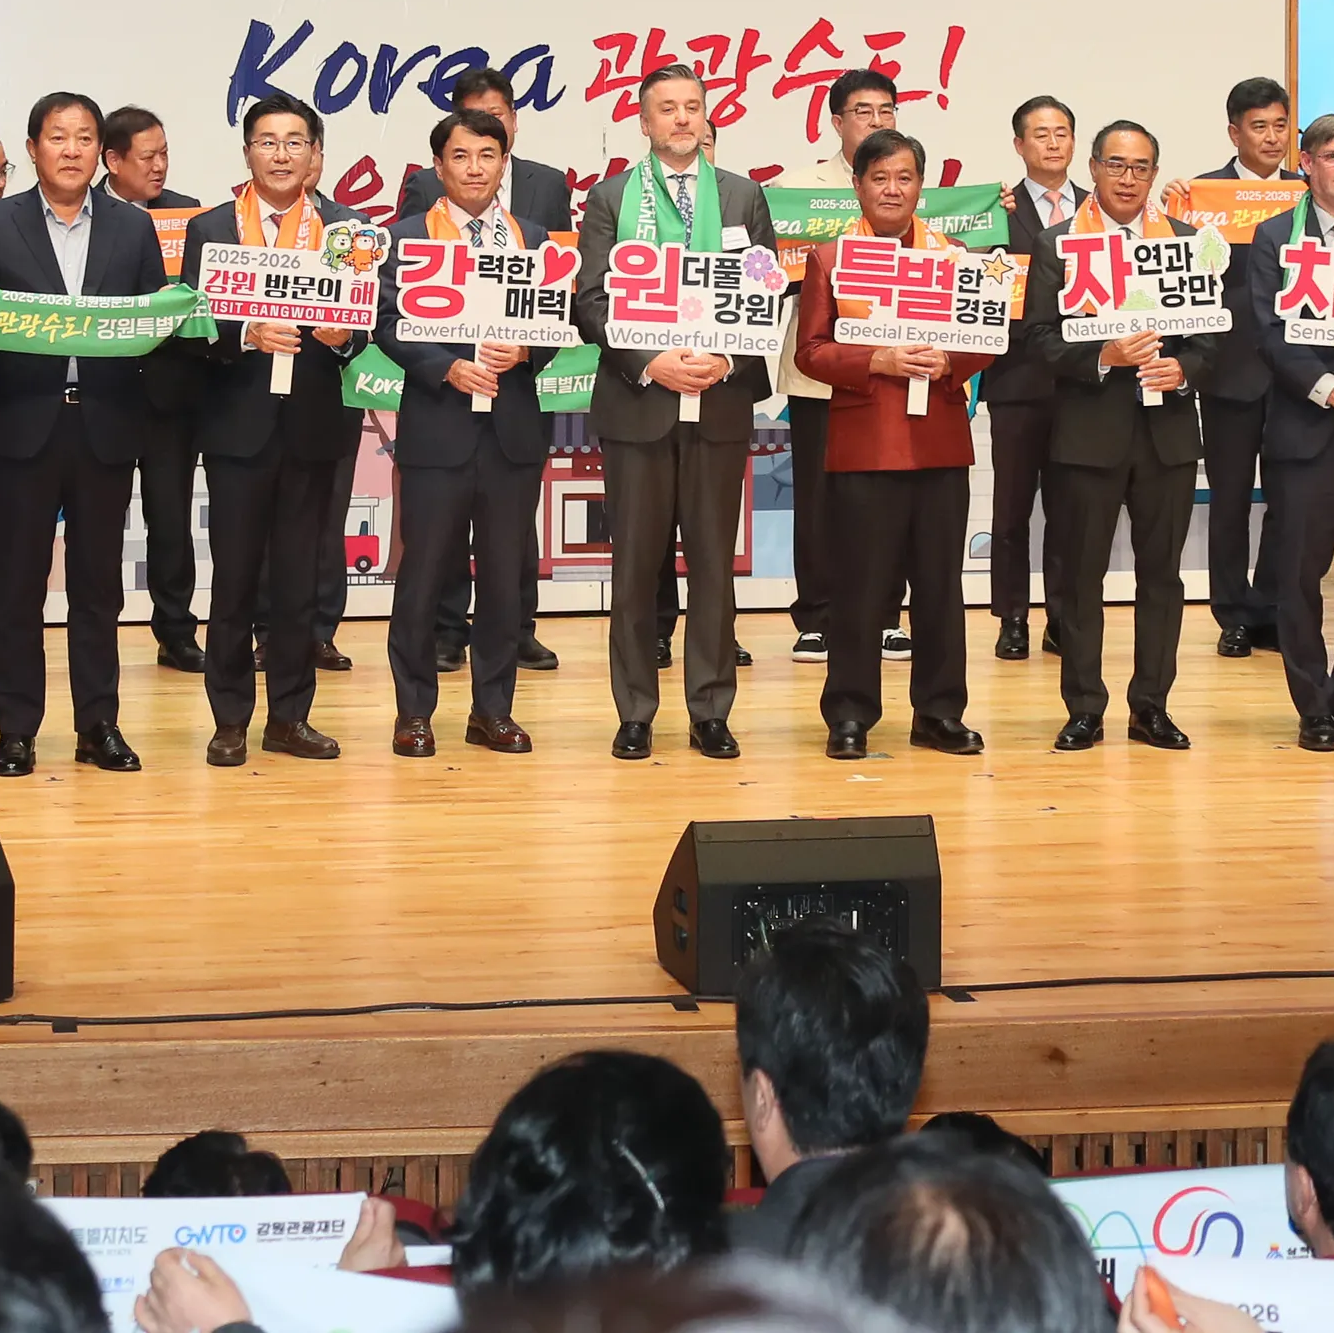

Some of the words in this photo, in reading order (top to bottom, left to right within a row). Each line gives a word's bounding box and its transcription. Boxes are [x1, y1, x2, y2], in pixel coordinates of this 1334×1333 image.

[226, 18, 567, 128] Korea
[584, 16, 966, 144] 관광수도!
[1235, 190, 1291, 202] 2025-2026
[207, 248, 301, 270] 2025-2026
[2, 290, 71, 306] 2025-2026
[204, 269, 257, 297] 강원
[264, 273, 343, 303] 방문의
[349, 279, 376, 306] 해
[1158, 274, 1219, 308] 낭만
[249, 305, 330, 322] GANGWON
[332, 310, 370, 324] YEAR
[505, 288, 567, 321] 매력
[714, 293, 775, 326] 강원
[955, 298, 1007, 328] 경험
[400, 321, 481, 339] Powerful
[484, 323, 574, 343] Attraction
[610, 326, 718, 348] Wonderful
[724, 332, 779, 351] Place
[839, 322, 902, 340] Special
[906, 326, 1005, 348] Experience
[1067, 322, 1126, 338] Nature
[1130, 318, 1142, 332] &
[1146, 315, 1227, 332] Romance
